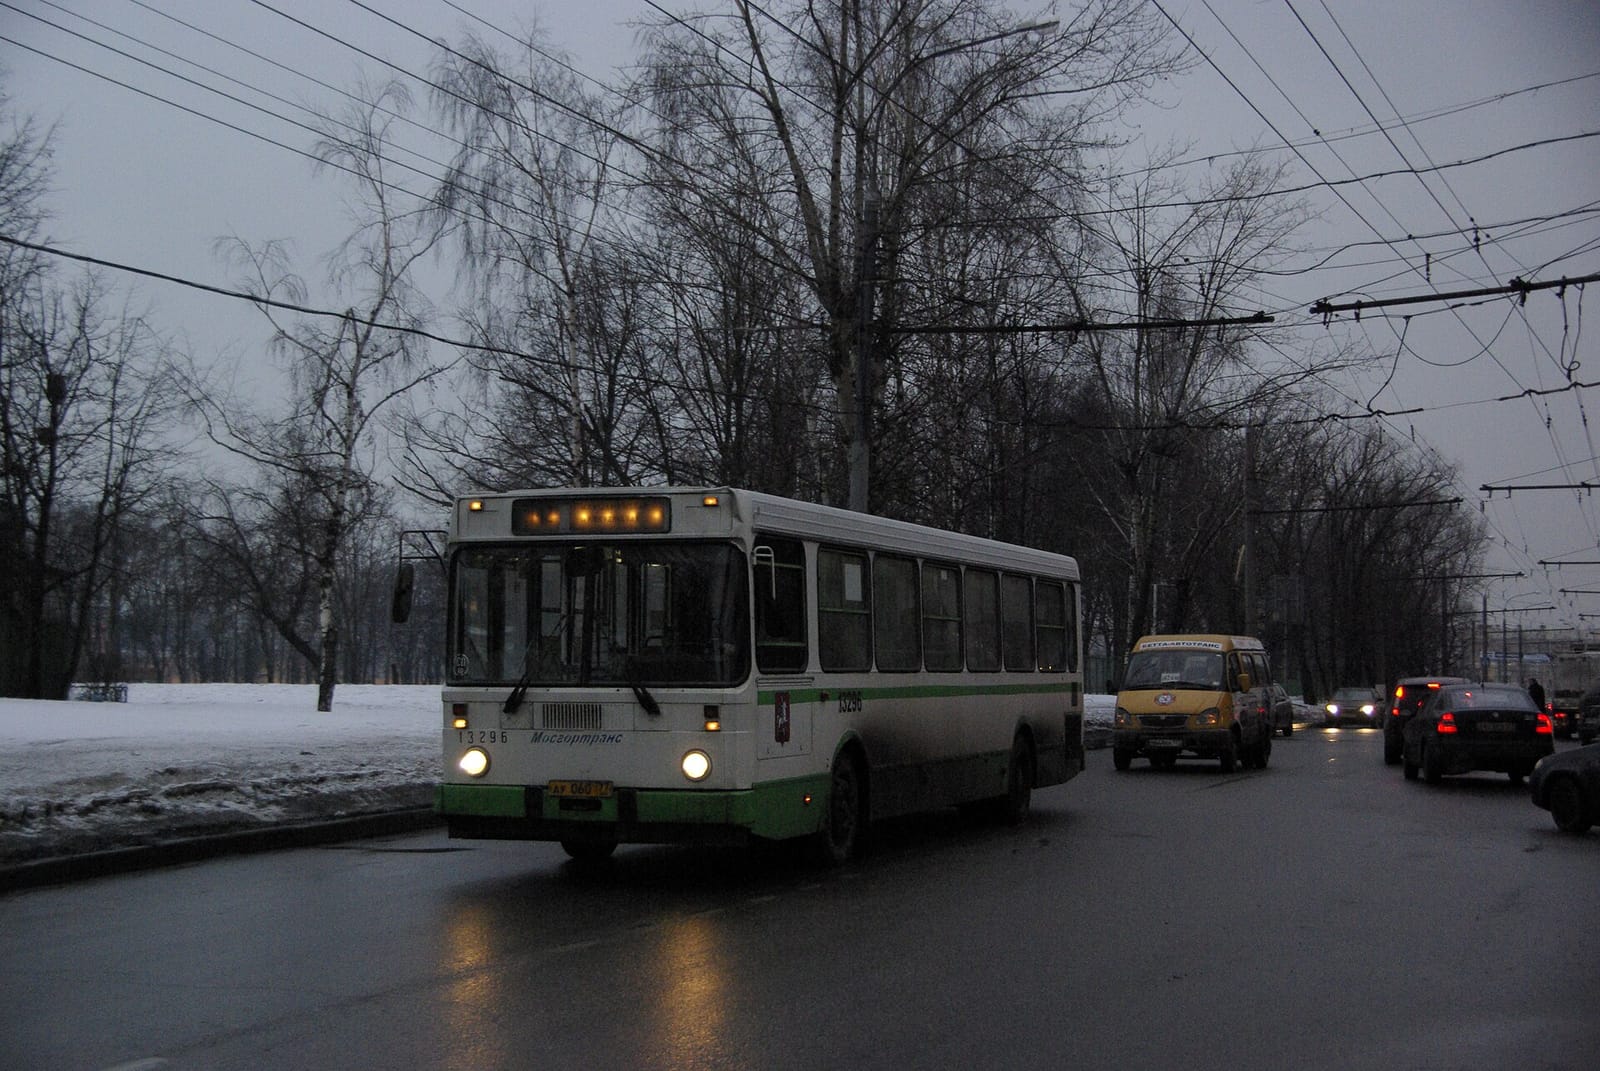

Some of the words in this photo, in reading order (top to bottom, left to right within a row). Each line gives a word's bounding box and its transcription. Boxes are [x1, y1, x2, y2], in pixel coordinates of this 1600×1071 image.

[838, 691, 862, 713] 13296
[459, 731, 508, 744] 13296
[530, 732, 623, 745] Мосгортранс
